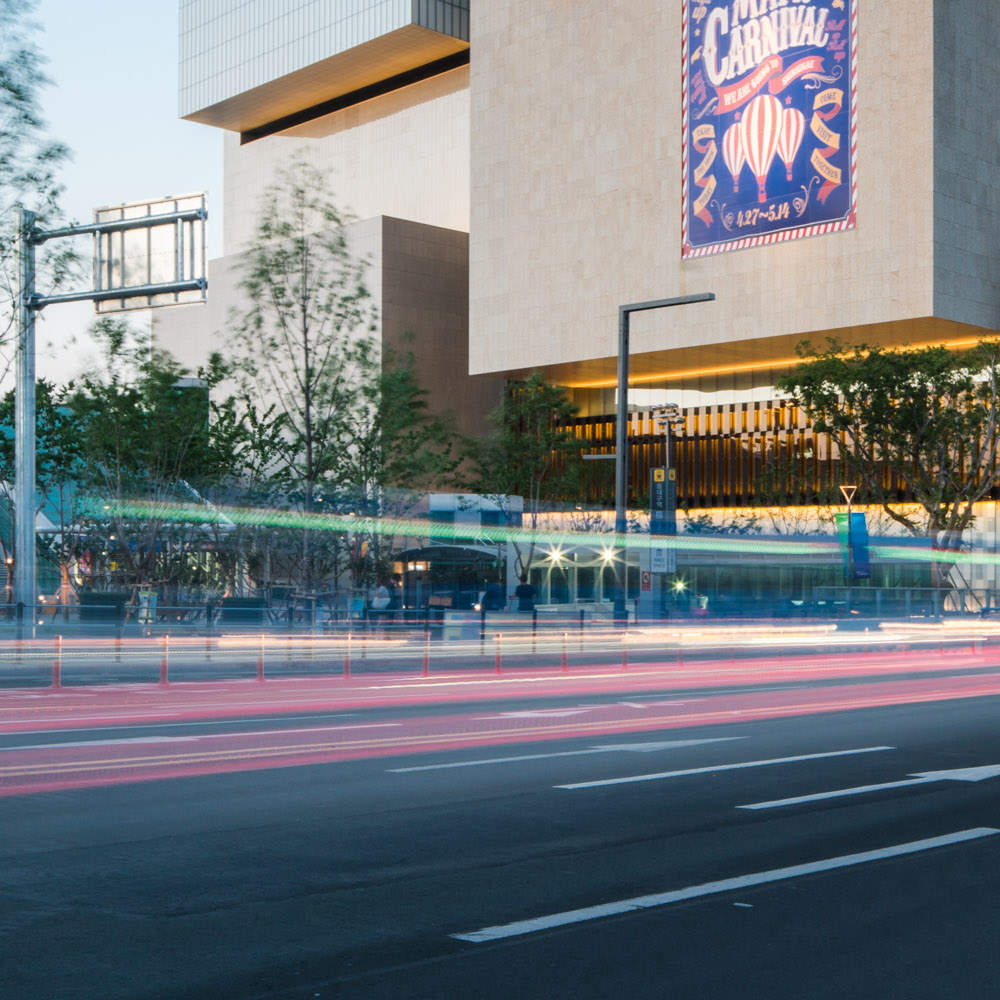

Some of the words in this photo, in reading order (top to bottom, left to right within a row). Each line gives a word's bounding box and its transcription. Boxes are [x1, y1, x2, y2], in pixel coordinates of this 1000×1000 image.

[702, 5, 829, 86] CARNIVAL
[723, 91, 737, 106] WE
[737, 83, 751, 101] ARE
[819, 92, 837, 104] COME
[816, 125, 833, 143] VISIT
[736, 202, 790, 228] 4.27~5.14
